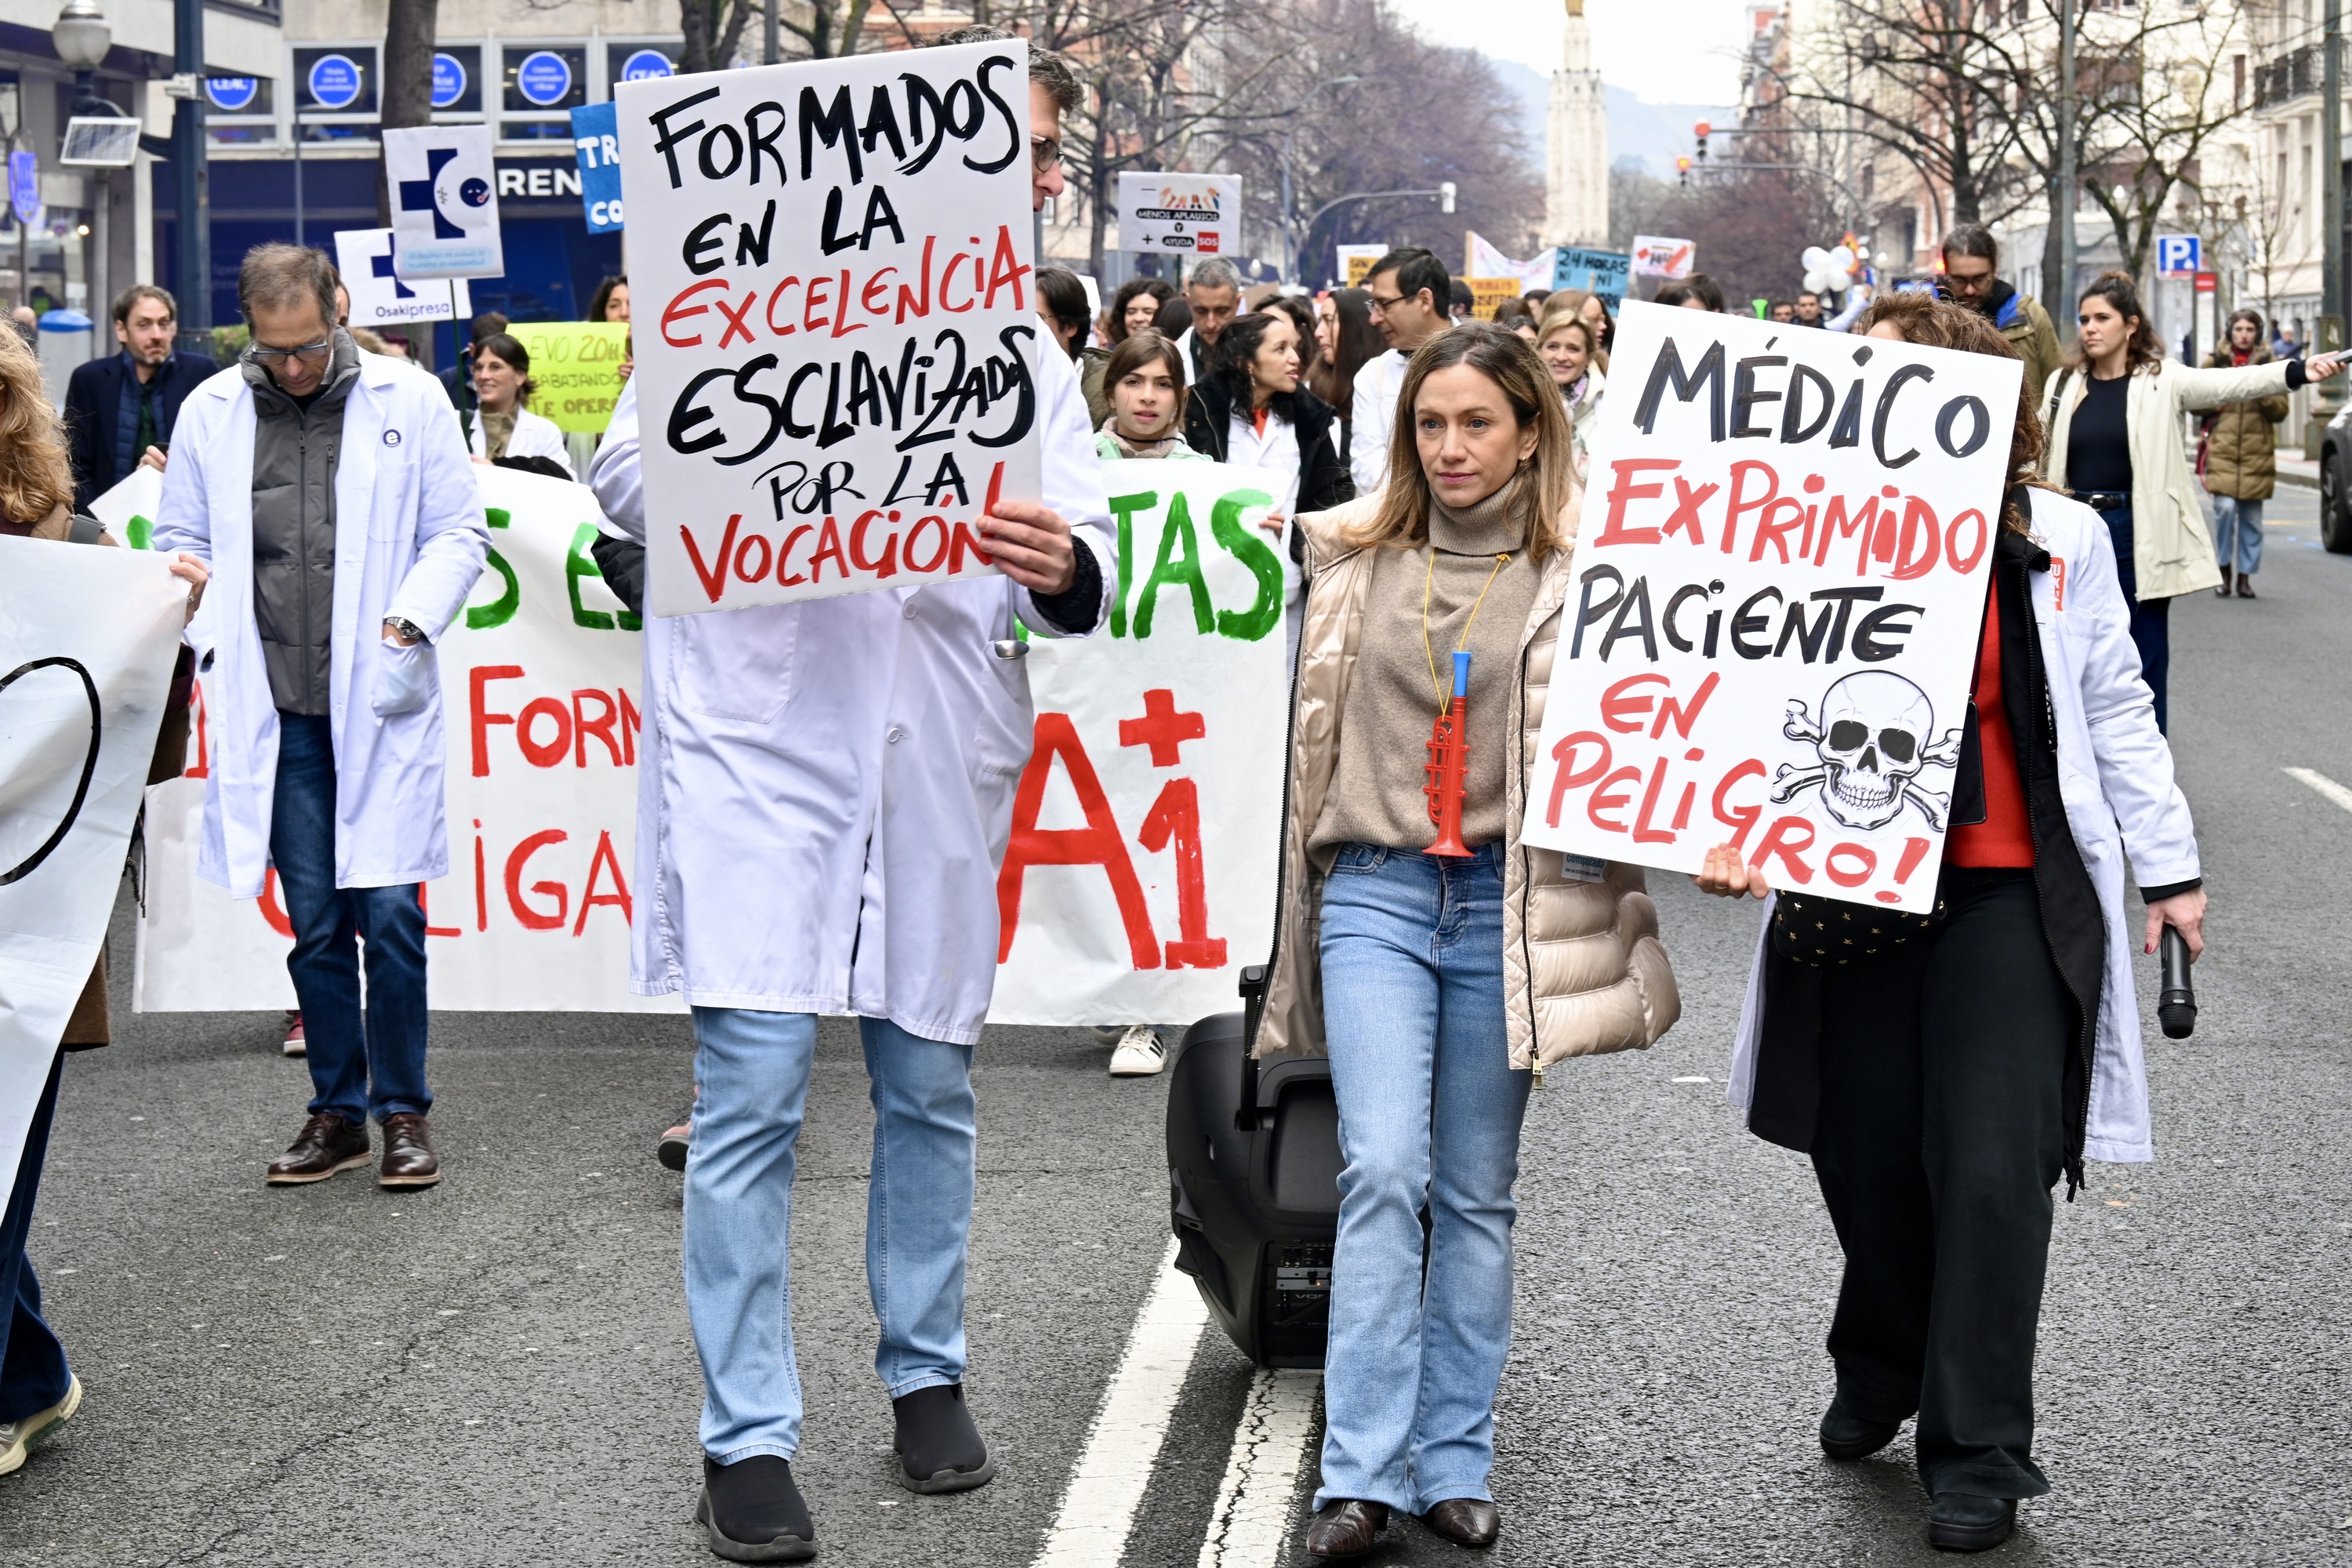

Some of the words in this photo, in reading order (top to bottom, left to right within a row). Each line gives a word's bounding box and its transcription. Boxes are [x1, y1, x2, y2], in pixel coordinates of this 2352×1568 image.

[649, 56, 1020, 189] FORMADOS
[683, 199, 776, 275] EN
[821, 184, 905, 256] LA
[1138, 209, 1171, 220] MENOS
[1174, 211, 1218, 221] APLAUSOS
[1176, 223, 1182, 232] Y
[1164, 238, 1193, 247] AYUDA
[1199, 238, 1218, 247] SOS
[2165, 238, 2191, 270] P
[1559, 251, 1581, 267] 24
[1584, 254, 1628, 274] HORAS
[661, 225, 1032, 350] EXCELENCIA
[1596, 274, 1611, 287] NI
[376, 303, 450, 319] Osakipresa
[528, 336, 570, 362] EVO
[752, 461, 866, 521] POR
[881, 452, 970, 506] LA
[1108, 488, 1284, 642] TAS
[1600, 672, 1720, 740] EN
